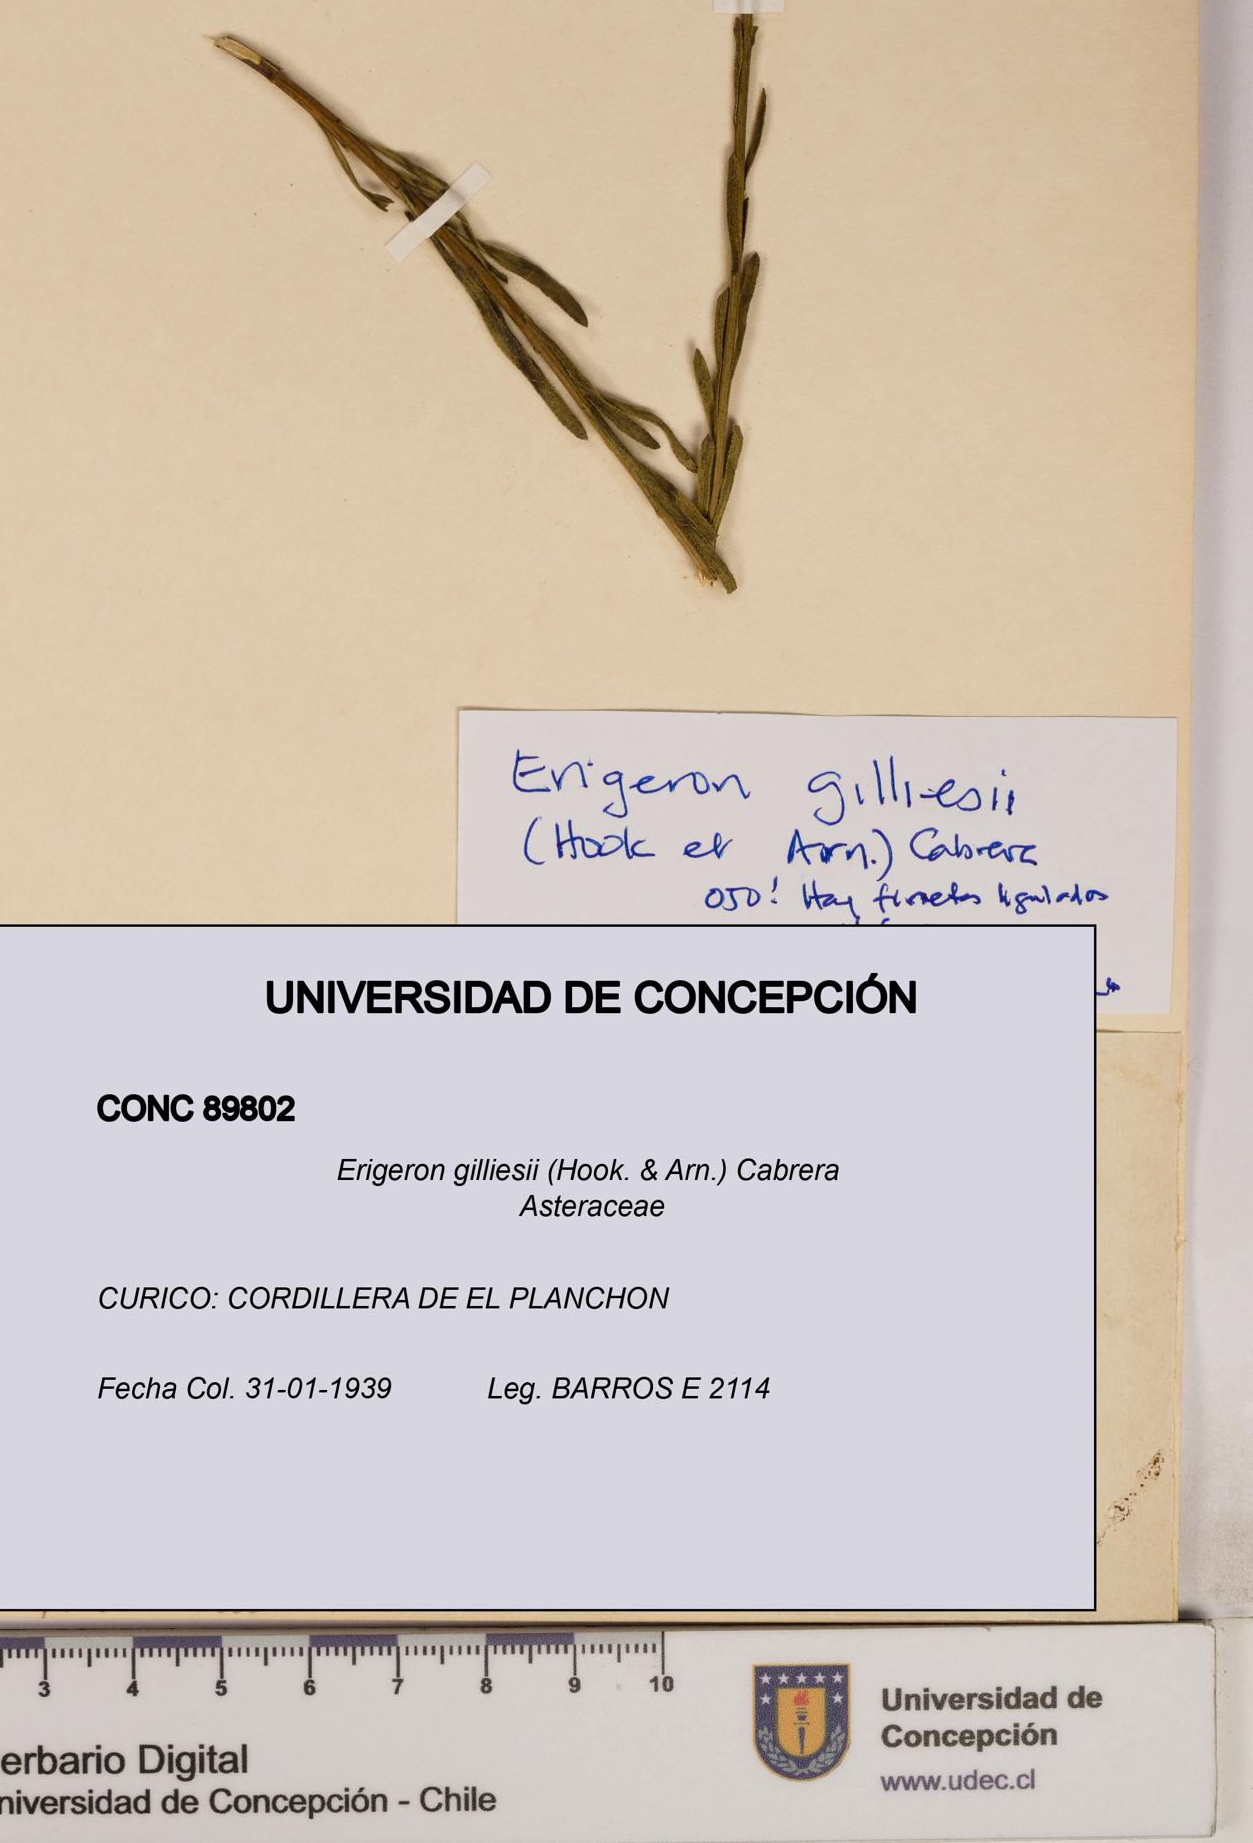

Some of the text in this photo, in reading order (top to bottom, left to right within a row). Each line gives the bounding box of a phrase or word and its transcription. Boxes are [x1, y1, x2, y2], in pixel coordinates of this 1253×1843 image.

[512, 748, 750, 819] Erigeron
[524, 818, 654, 865] (Hook
[38, 1681, 51, 1697] 3
[126, 1681, 139, 1697] 4
[215, 1680, 227, 1696] 5
[303, 1680, 316, 1696] 6
[392, 1679, 404, 1695] 7
[480, 1679, 492, 1695] 8
[568, 1677, 581, 1693] 9
[650, 1677, 675, 1693] 10
[881, 1685, 1103, 1712] Universidad de
[881, 1722, 1058, 1753] Concepción
[139, 1744, 248, 1783] Digital
[880, 1768, 1036, 1792] www.udec.cl
[161, 1788, 200, 1815] de
[209, 1787, 388, 1821] Concepción
[420, 1786, 497, 1813] Chile
